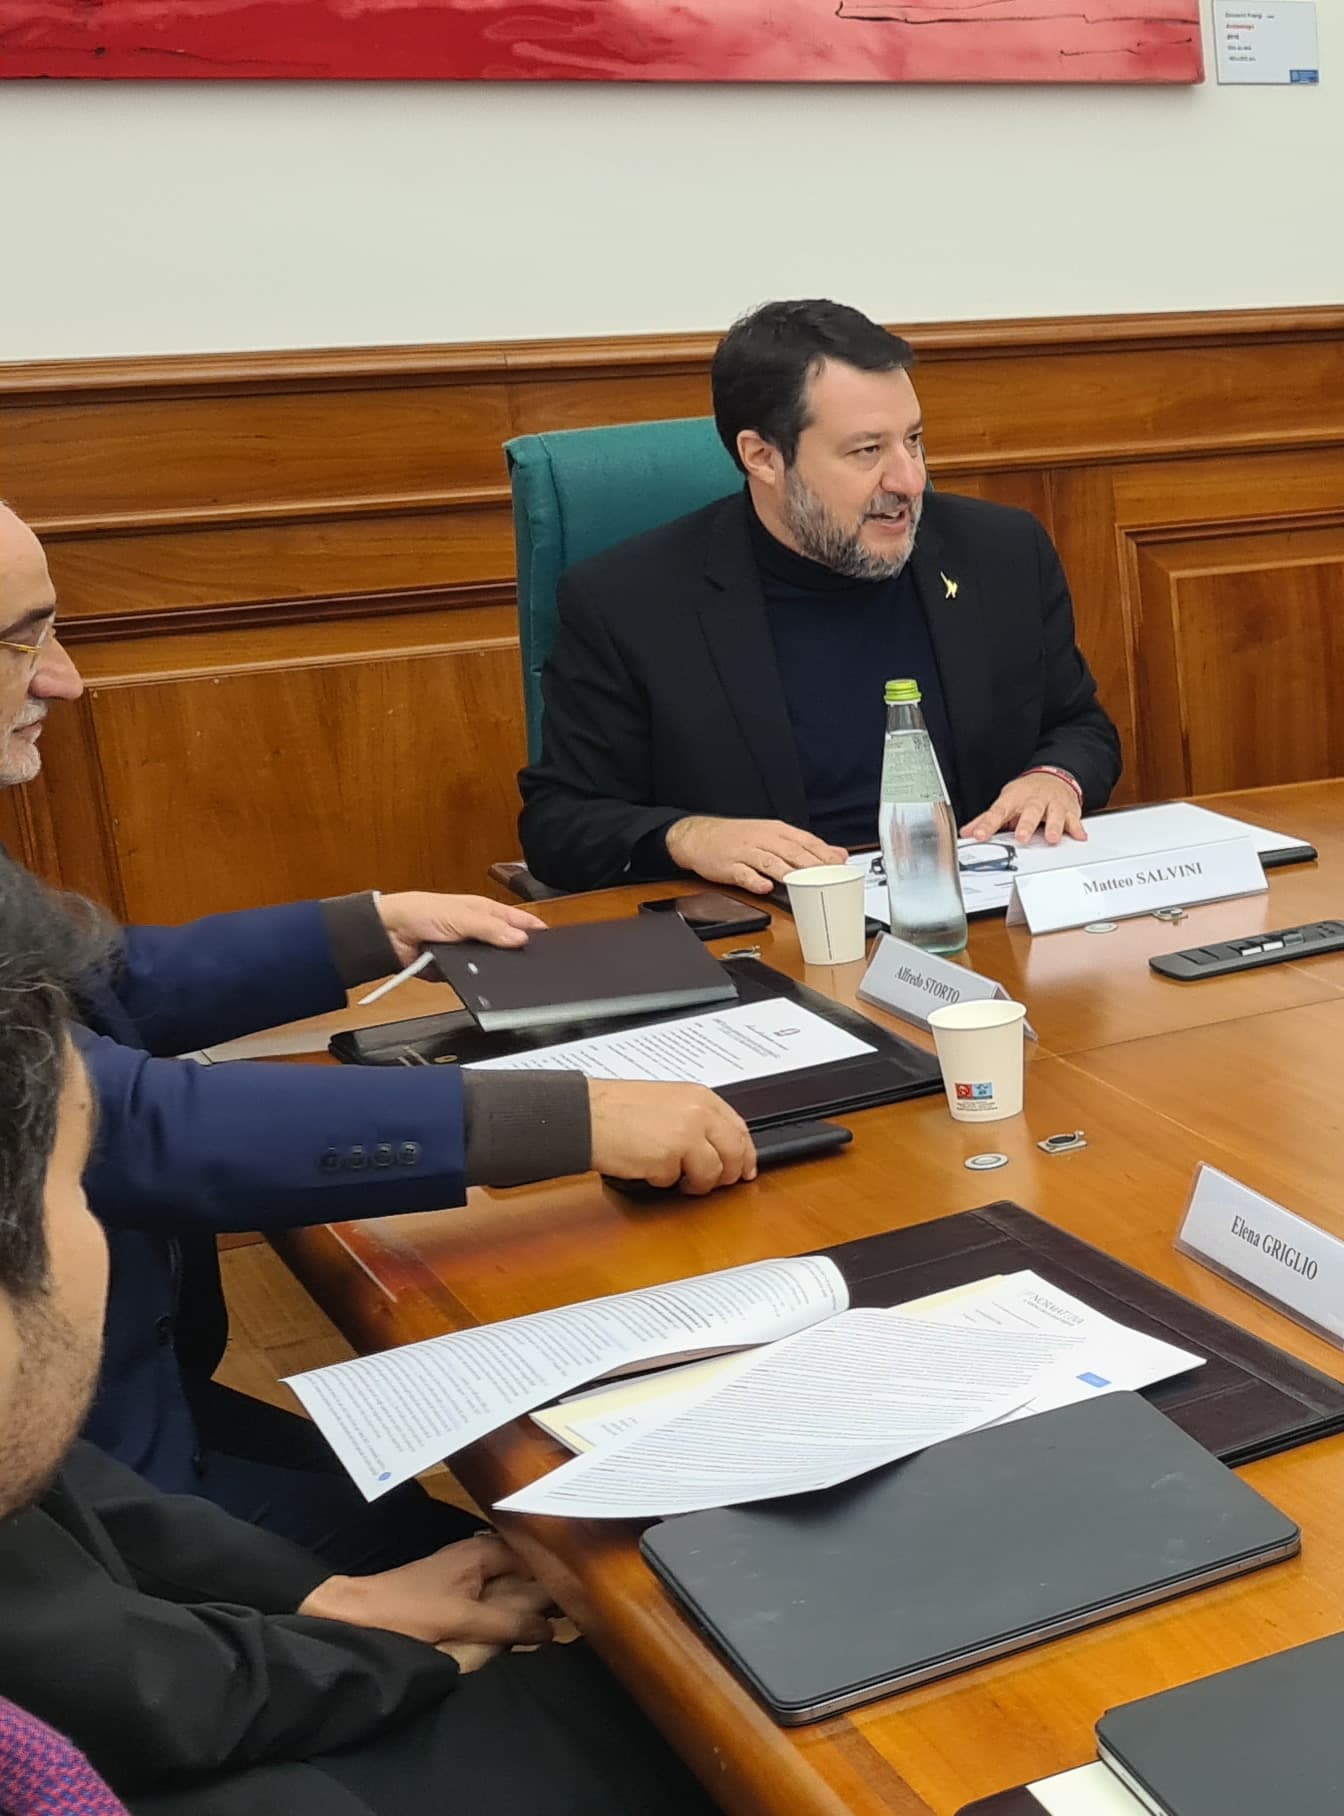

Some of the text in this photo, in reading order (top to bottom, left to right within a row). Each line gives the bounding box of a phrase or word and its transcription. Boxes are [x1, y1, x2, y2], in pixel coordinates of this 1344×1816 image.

[1083, 861, 1203, 895] Matteo SALVINI
[894, 966, 961, 1004] Alfredo STORTO
[1230, 1215, 1319, 1280] Elena GRIGLIO
